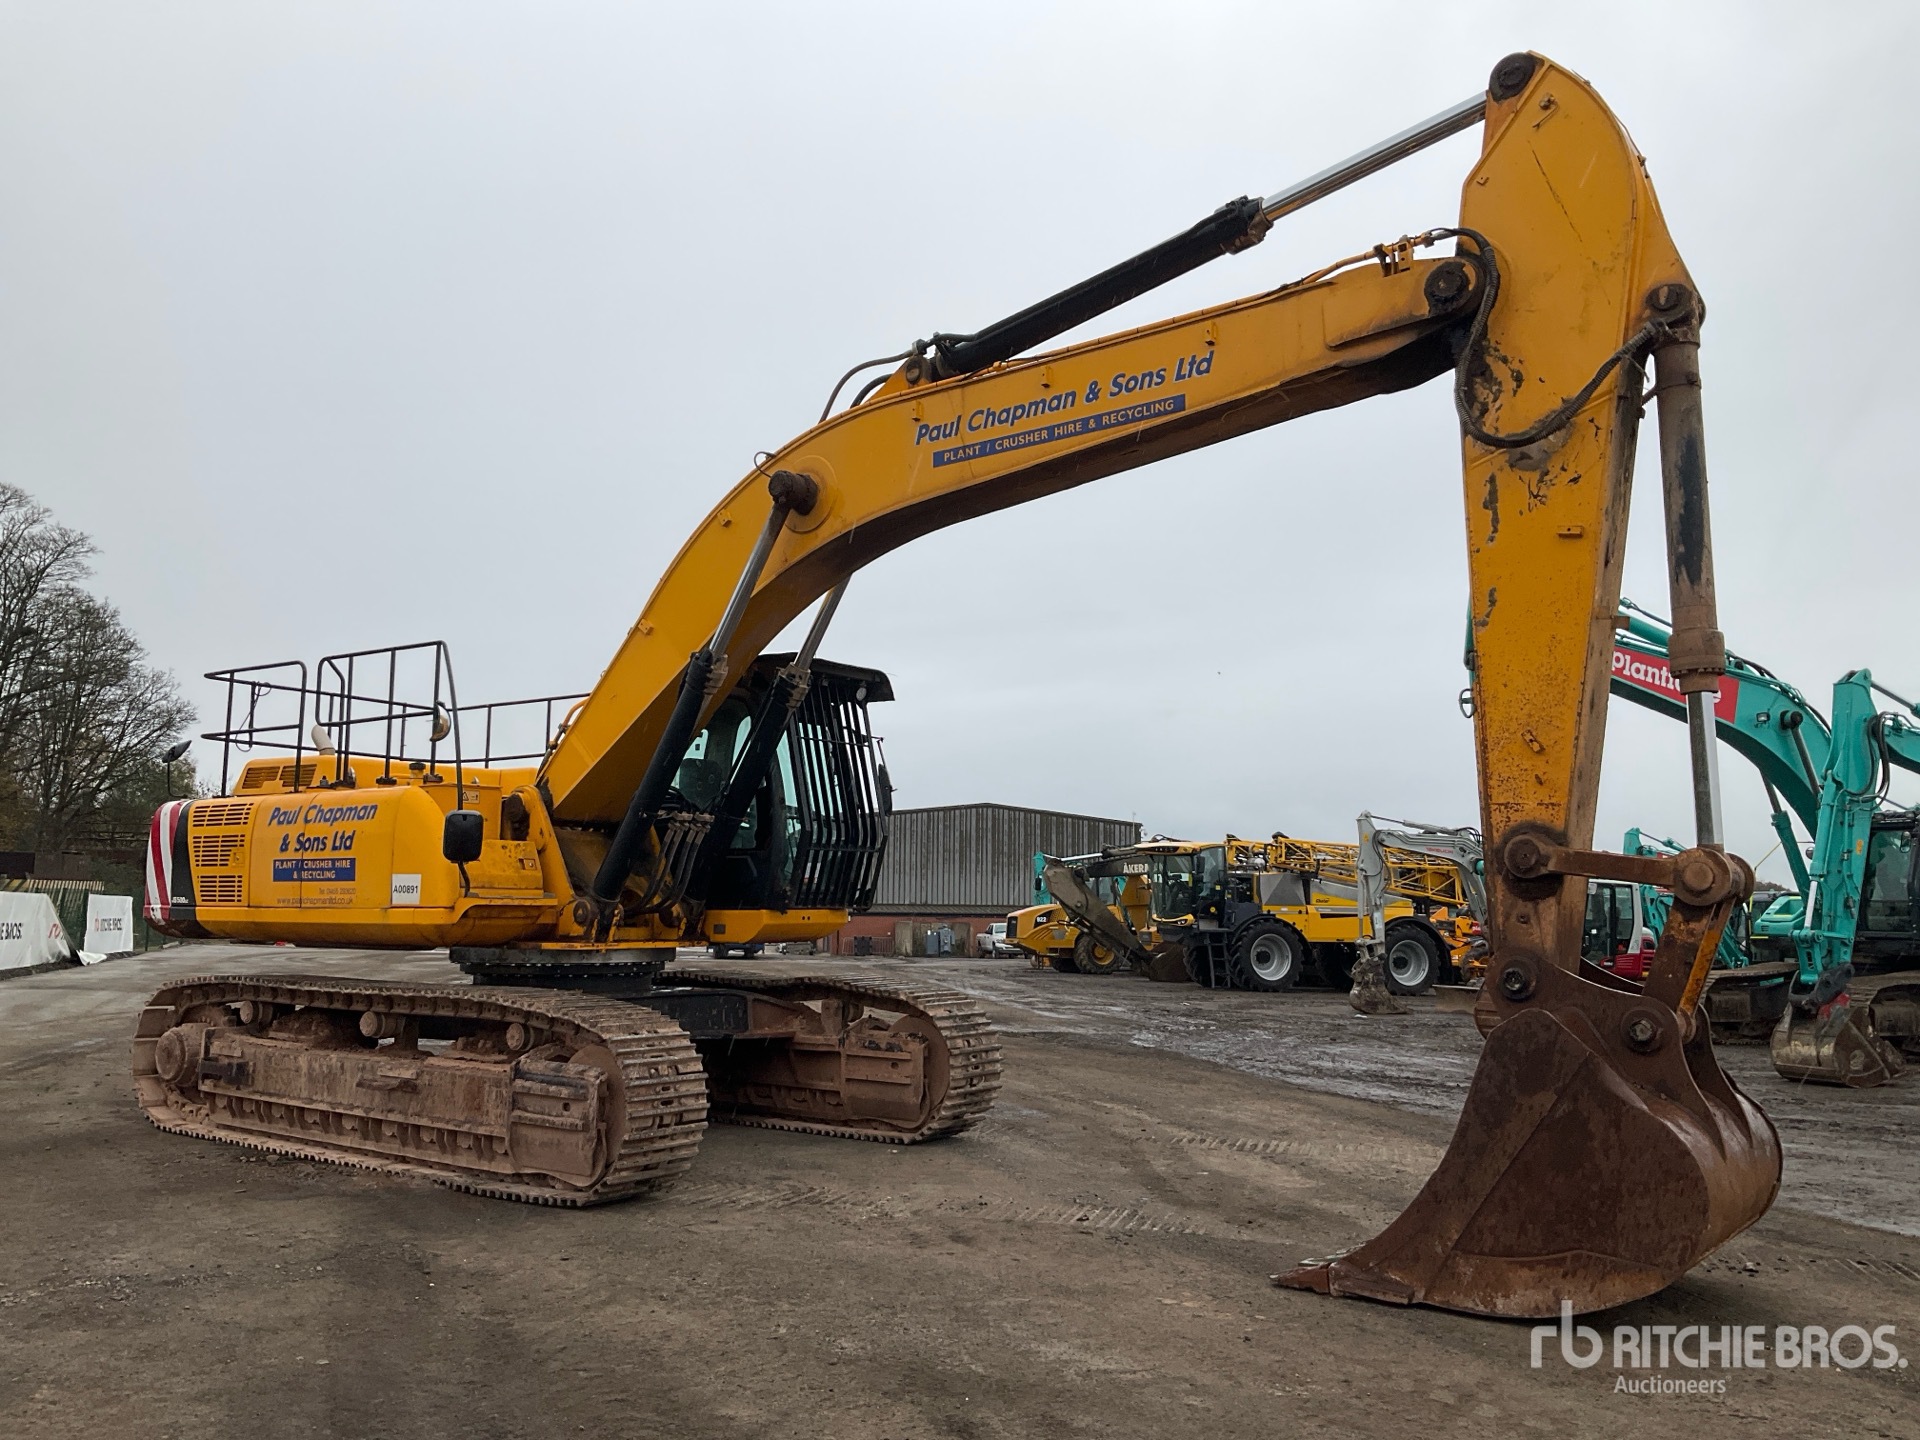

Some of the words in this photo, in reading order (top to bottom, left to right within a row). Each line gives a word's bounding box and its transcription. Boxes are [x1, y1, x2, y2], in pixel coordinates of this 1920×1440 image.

[915, 416, 962, 446] Paul
[967, 390, 1078, 429] Chapman
[1084, 380, 1102, 403] &
[1109, 368, 1167, 398] Sons
[1173, 350, 1215, 383] Ltd
[943, 444, 981, 462] PLANT
[995, 428, 1049, 451] CRUSHER
[1054, 420, 1083, 437] HIRE
[1088, 418, 1097, 429] &
[1102, 400, 1175, 427] RECYCLING
[268, 806, 302, 827] Paul
[303, 804, 379, 826] Chapman
[279, 832, 290, 853] &
[294, 832, 328, 853] Sons
[330, 830, 356, 851] Ltd
[275, 861, 296, 869] PLANT
[303, 860, 333, 869] CRUSHER
[335, 860, 351, 868] HIRE
[301, 870, 336, 879] RECYCLING
[393, 885, 419, 894] A00891
